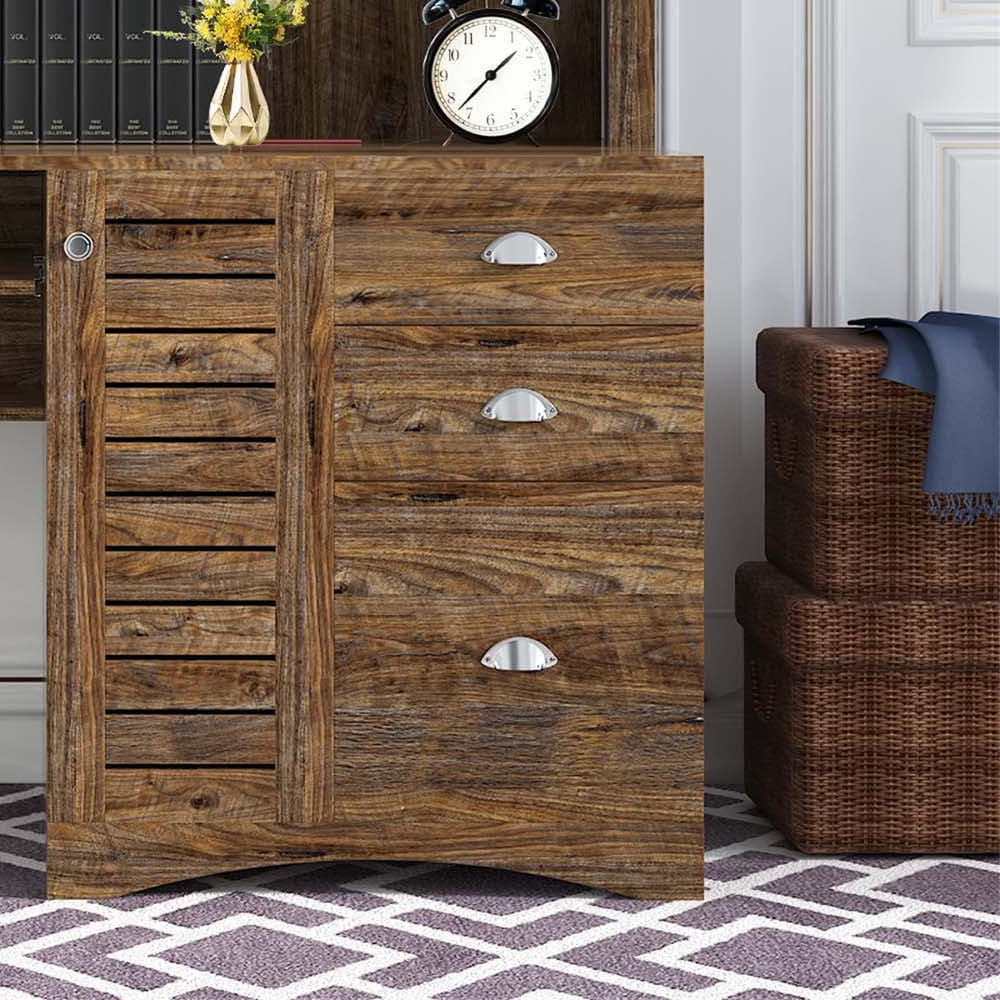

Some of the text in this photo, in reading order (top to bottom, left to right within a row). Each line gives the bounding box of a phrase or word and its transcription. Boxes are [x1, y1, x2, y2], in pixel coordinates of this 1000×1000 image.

[484, 26, 496, 37] 12
[510, 32, 515, 43] 1
[464, 33, 473, 45] 11
[448, 50, 459, 61] 10
[525, 48, 533, 59] 2
[440, 70, 448, 82] 9
[448, 92, 456, 104] 8
[466, 107, 474, 119] 7
[487, 113, 495, 125] 6
[510, 108, 518, 120] 5
